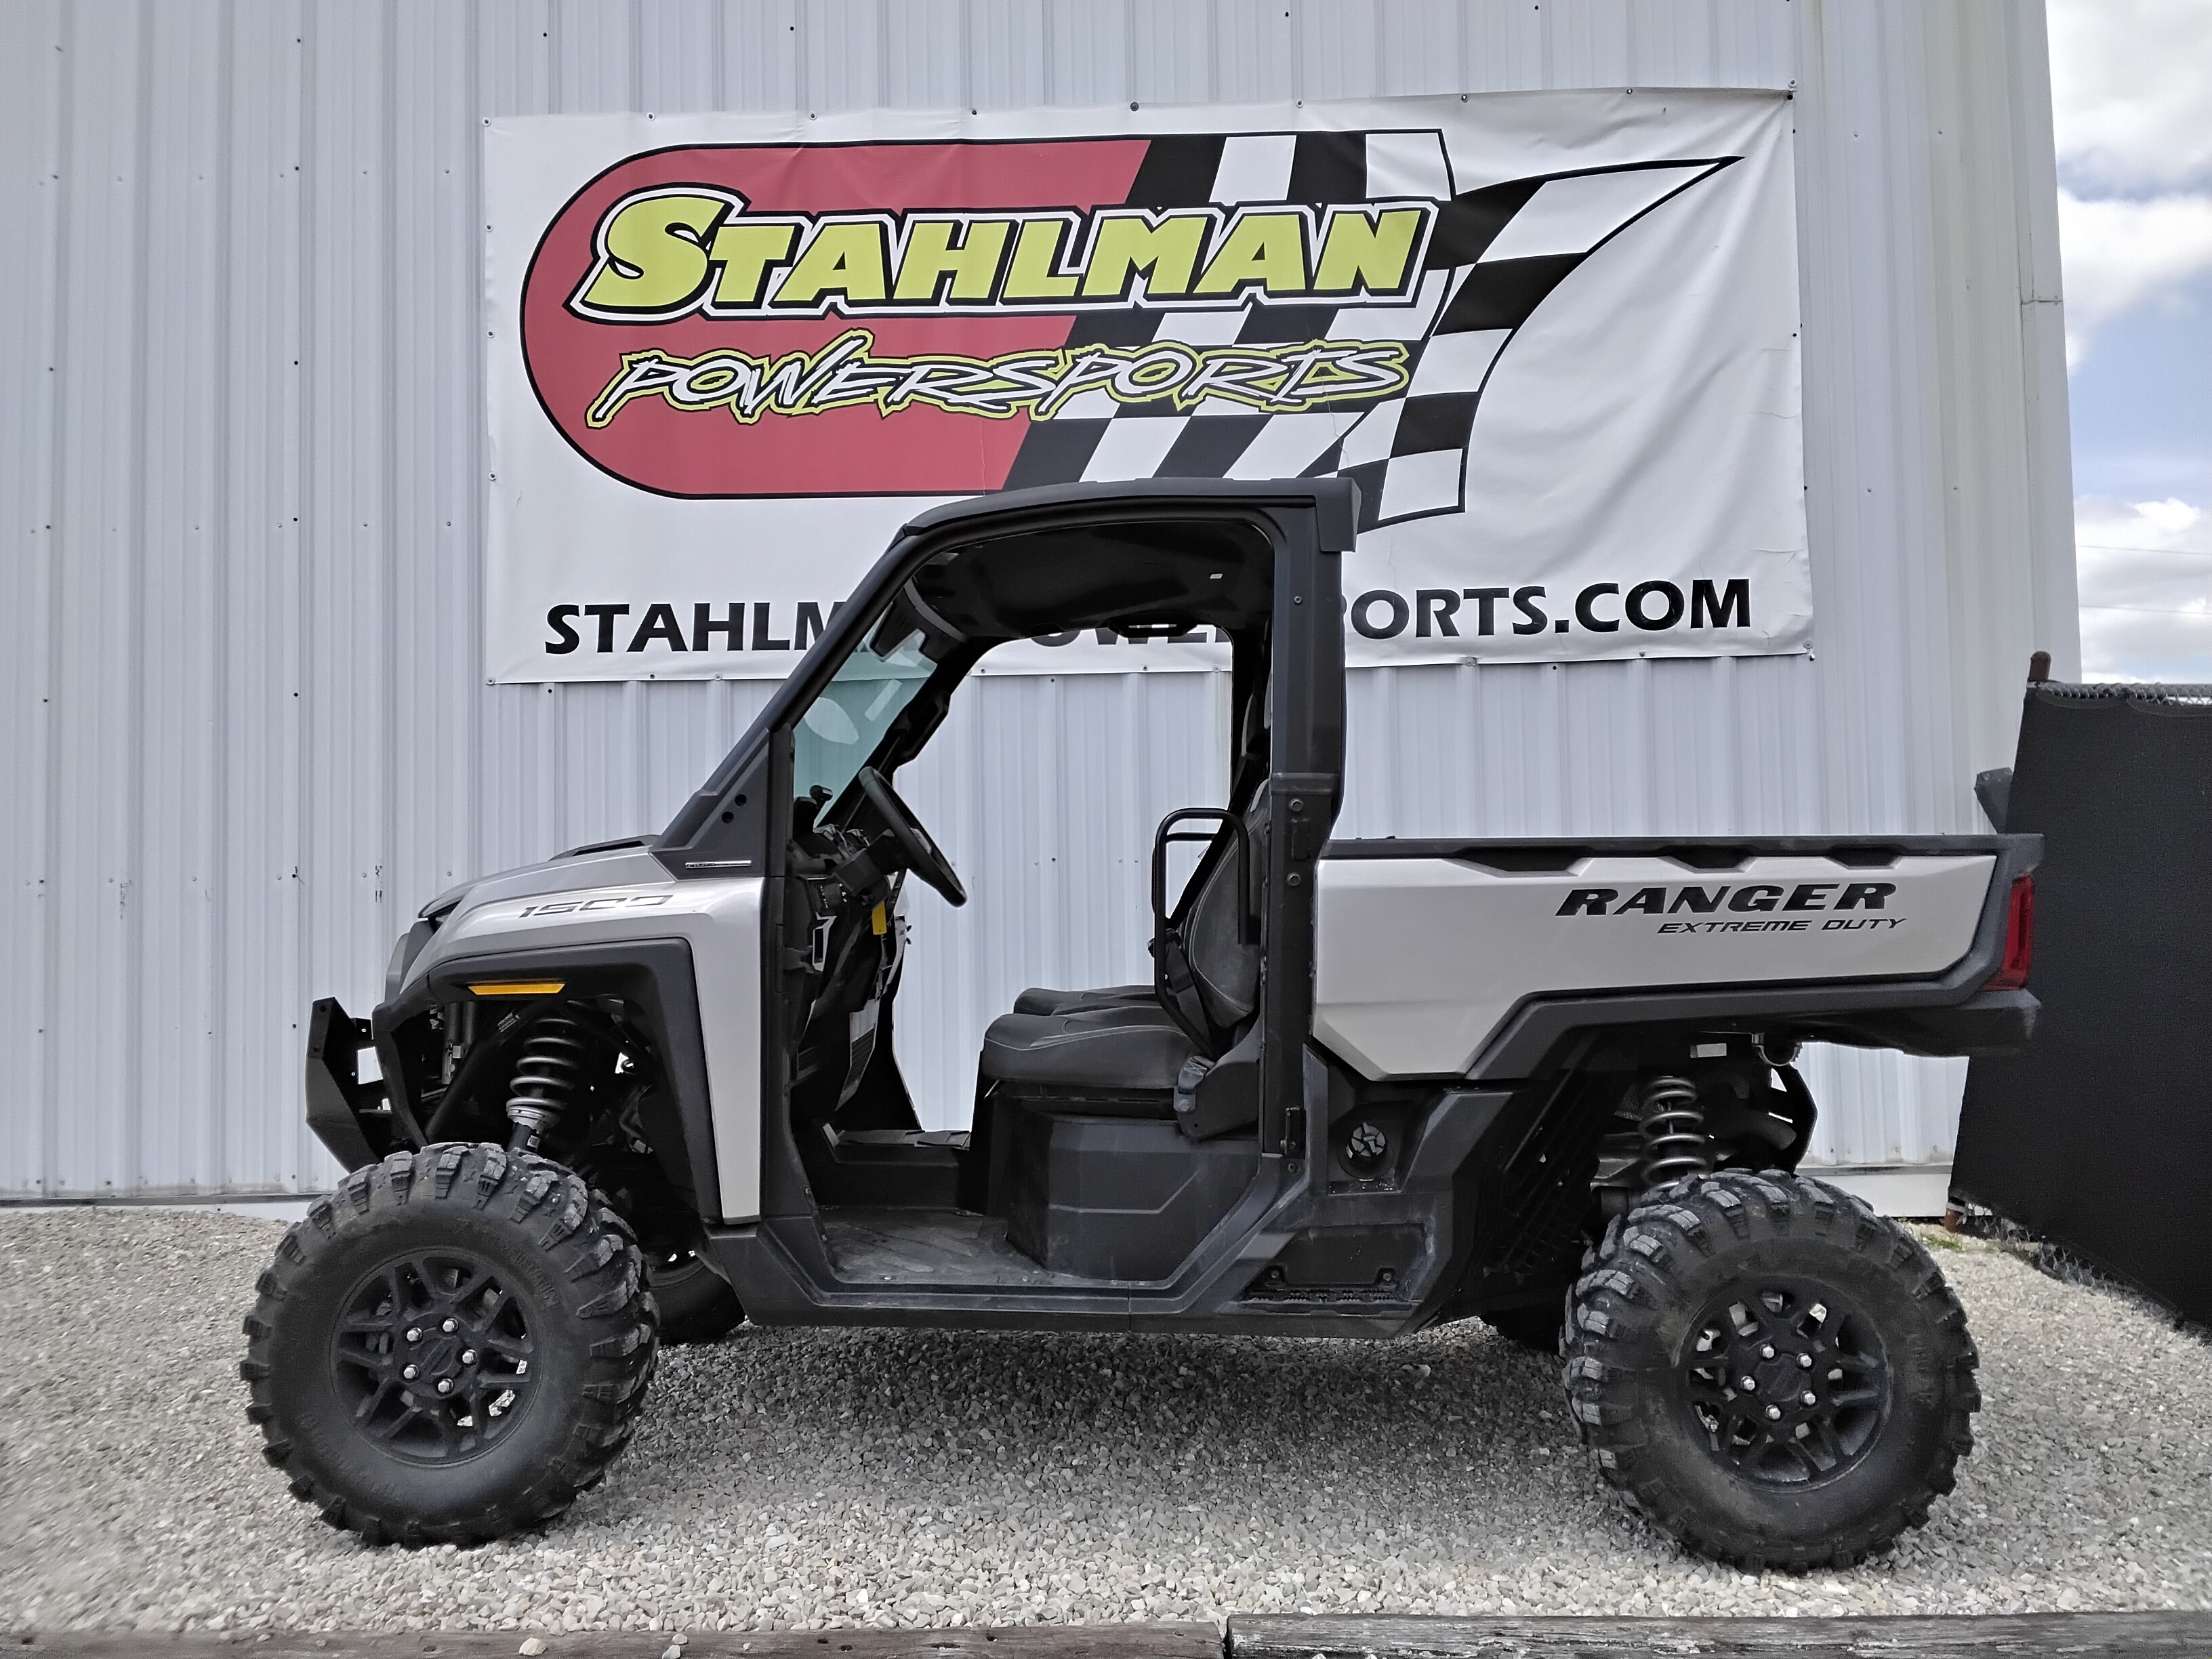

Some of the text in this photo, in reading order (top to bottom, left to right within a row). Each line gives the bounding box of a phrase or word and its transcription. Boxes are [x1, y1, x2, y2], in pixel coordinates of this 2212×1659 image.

[568, 186, 1439, 321] STAHLMAN
[588, 329, 1410, 427] POWERSPORTS
[1555, 882, 1897, 917] RANGER
[1657, 918, 1906, 934] EXTREME DUTY
